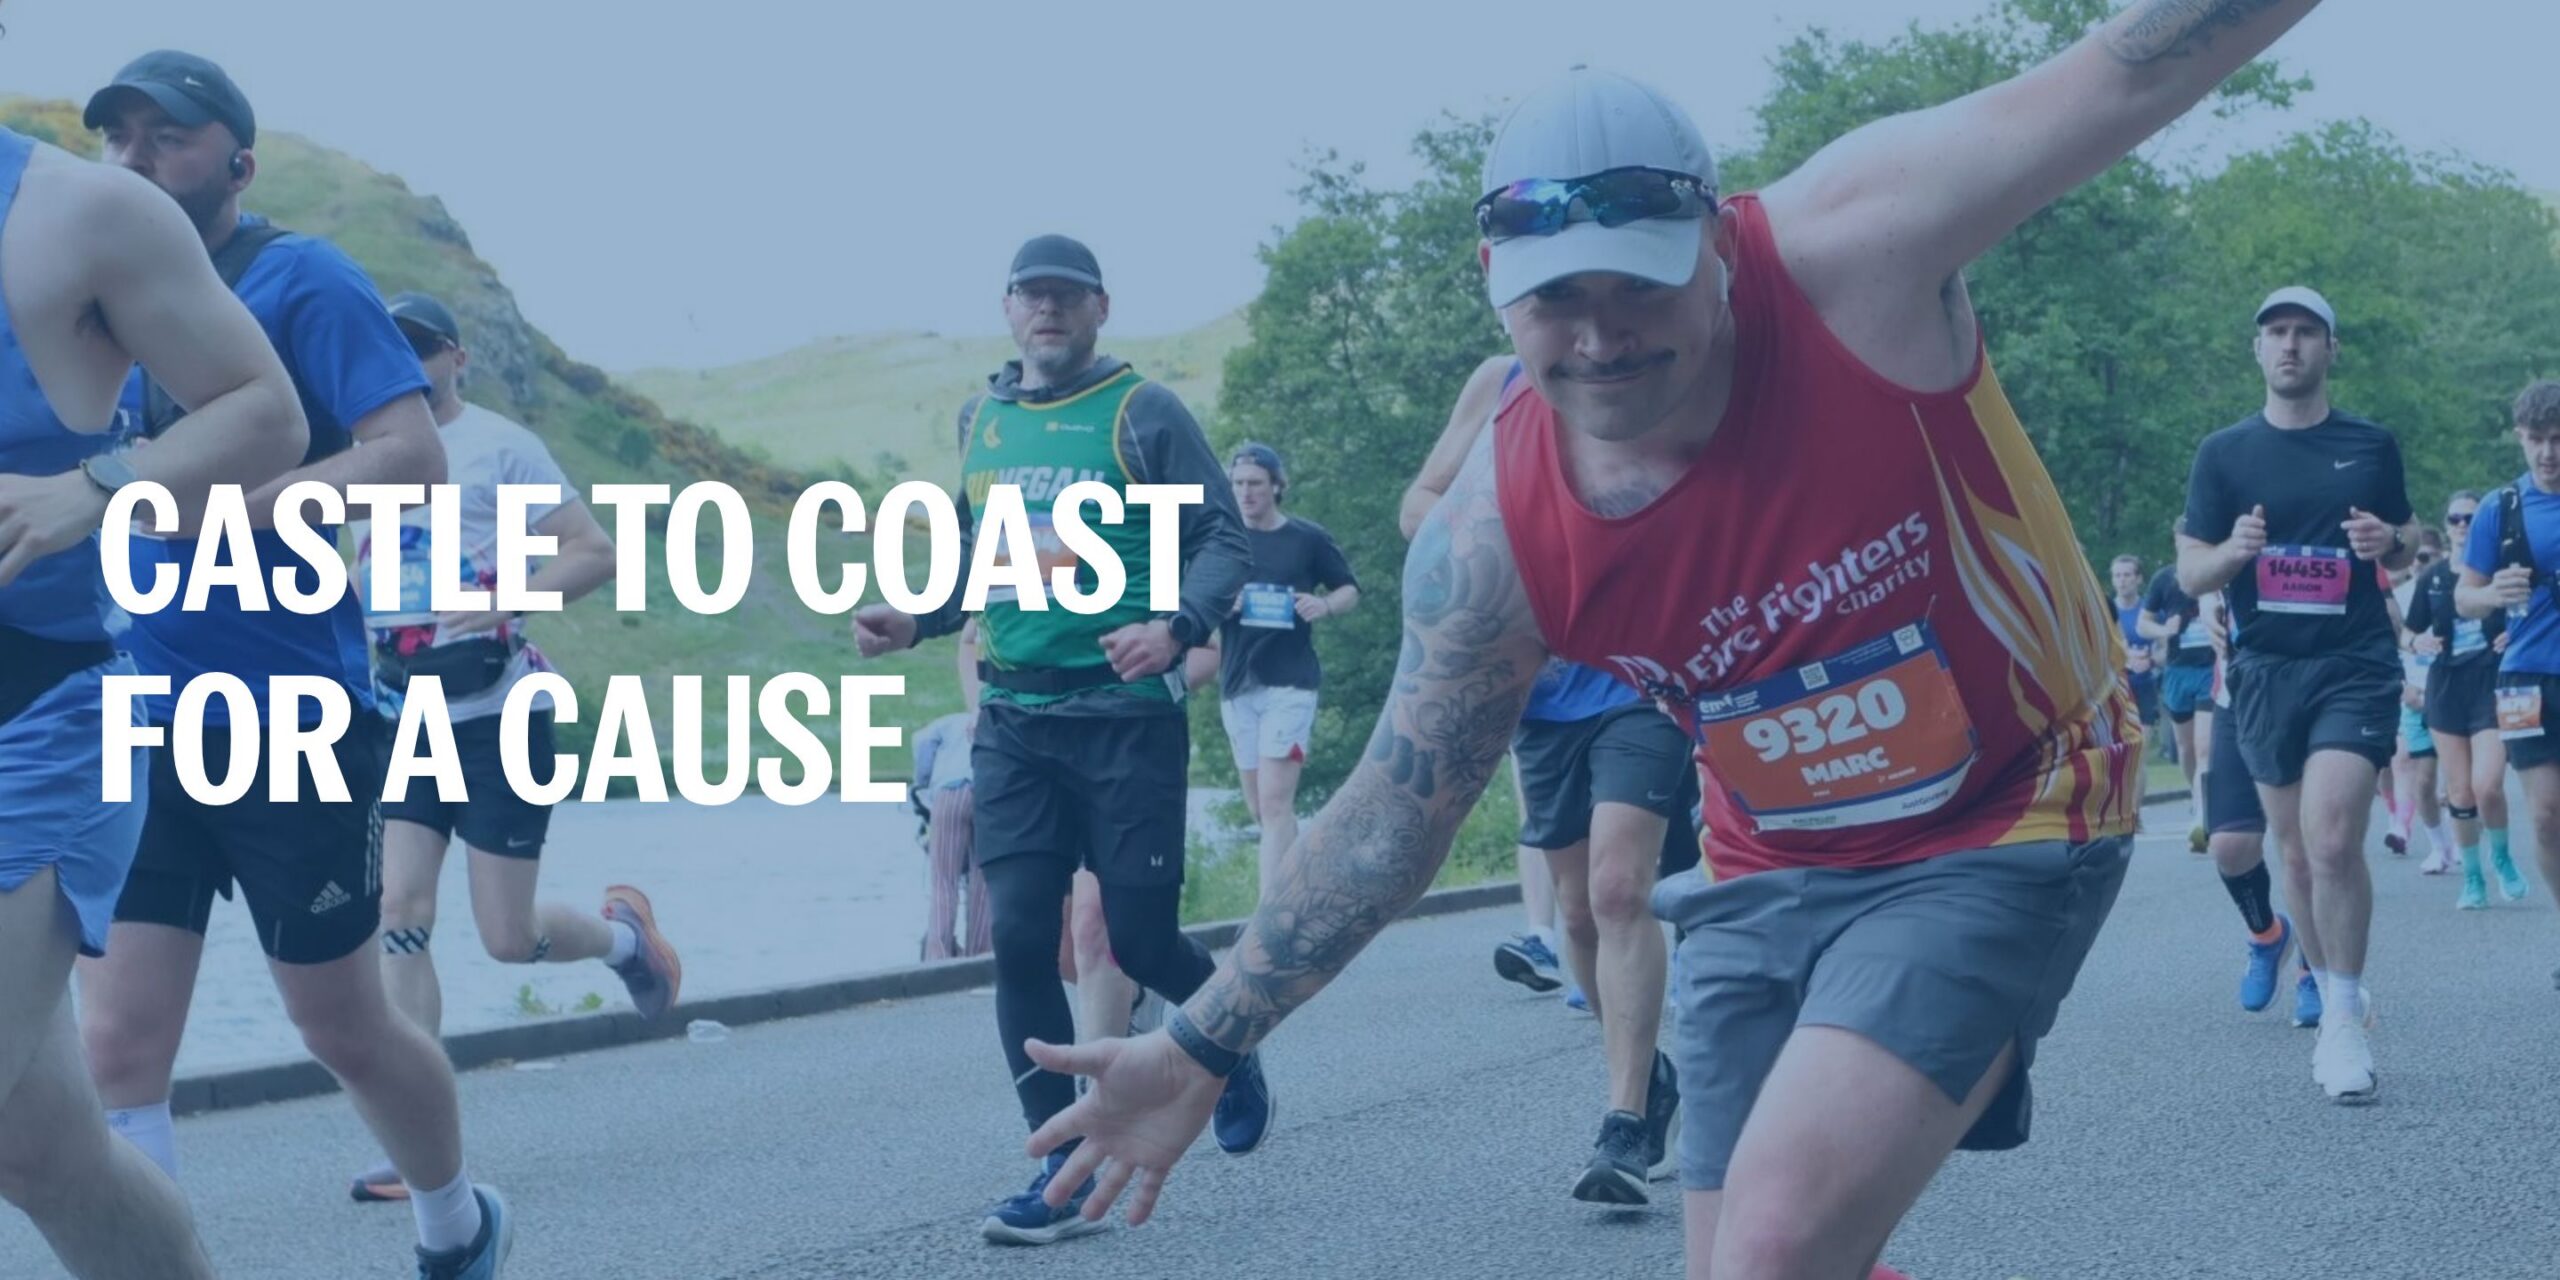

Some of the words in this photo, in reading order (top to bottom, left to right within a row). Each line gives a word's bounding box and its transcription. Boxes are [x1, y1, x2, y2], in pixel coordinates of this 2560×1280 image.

[2267, 559, 2338, 579] 14455
[1685, 624, 1761, 681] Fire
[1757, 511, 1928, 634] Fighters
[1699, 595, 1749, 638] The
[1743, 678, 1906, 763] 9320
[1801, 745, 1890, 786] MARC
